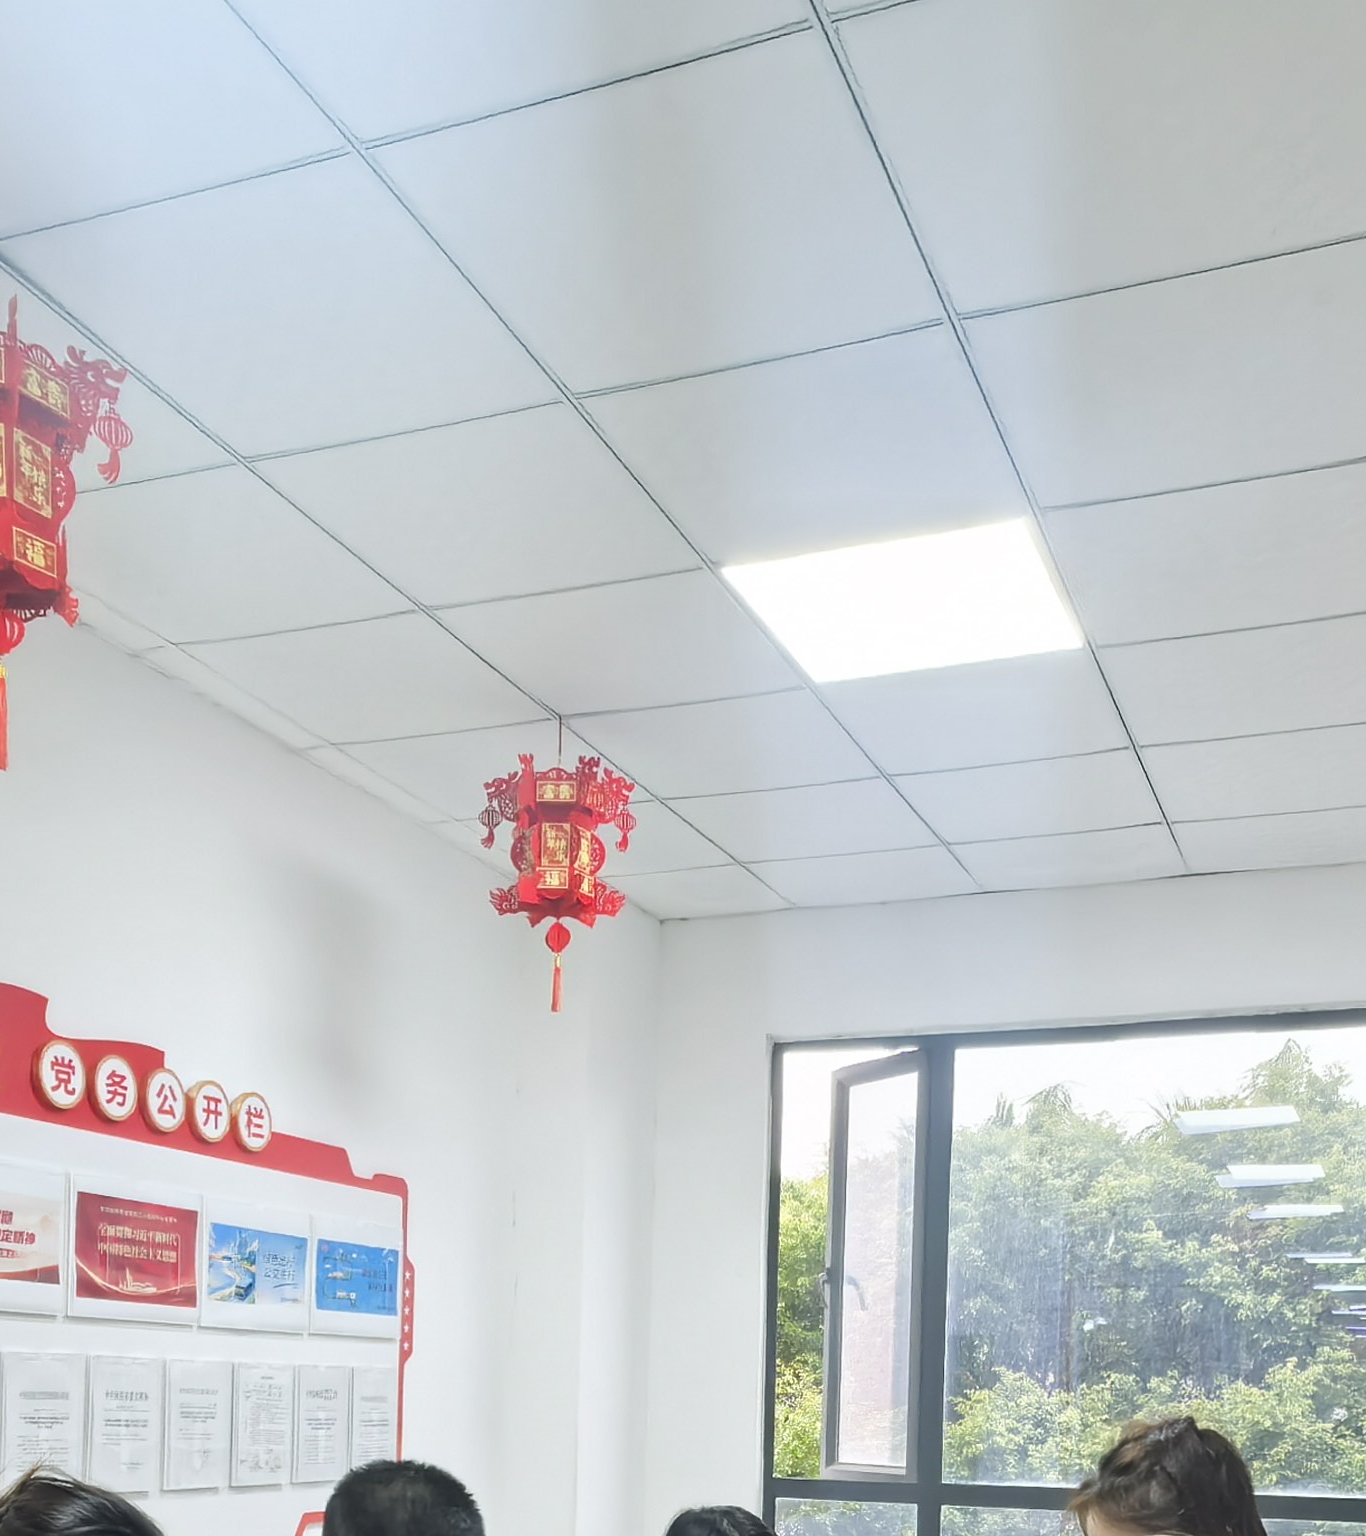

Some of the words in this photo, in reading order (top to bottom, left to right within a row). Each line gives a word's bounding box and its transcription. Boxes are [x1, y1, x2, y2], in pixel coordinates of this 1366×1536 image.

[25, 537, 46, 568] 福
[50, 1055, 265, 1139] 党务公开栏
